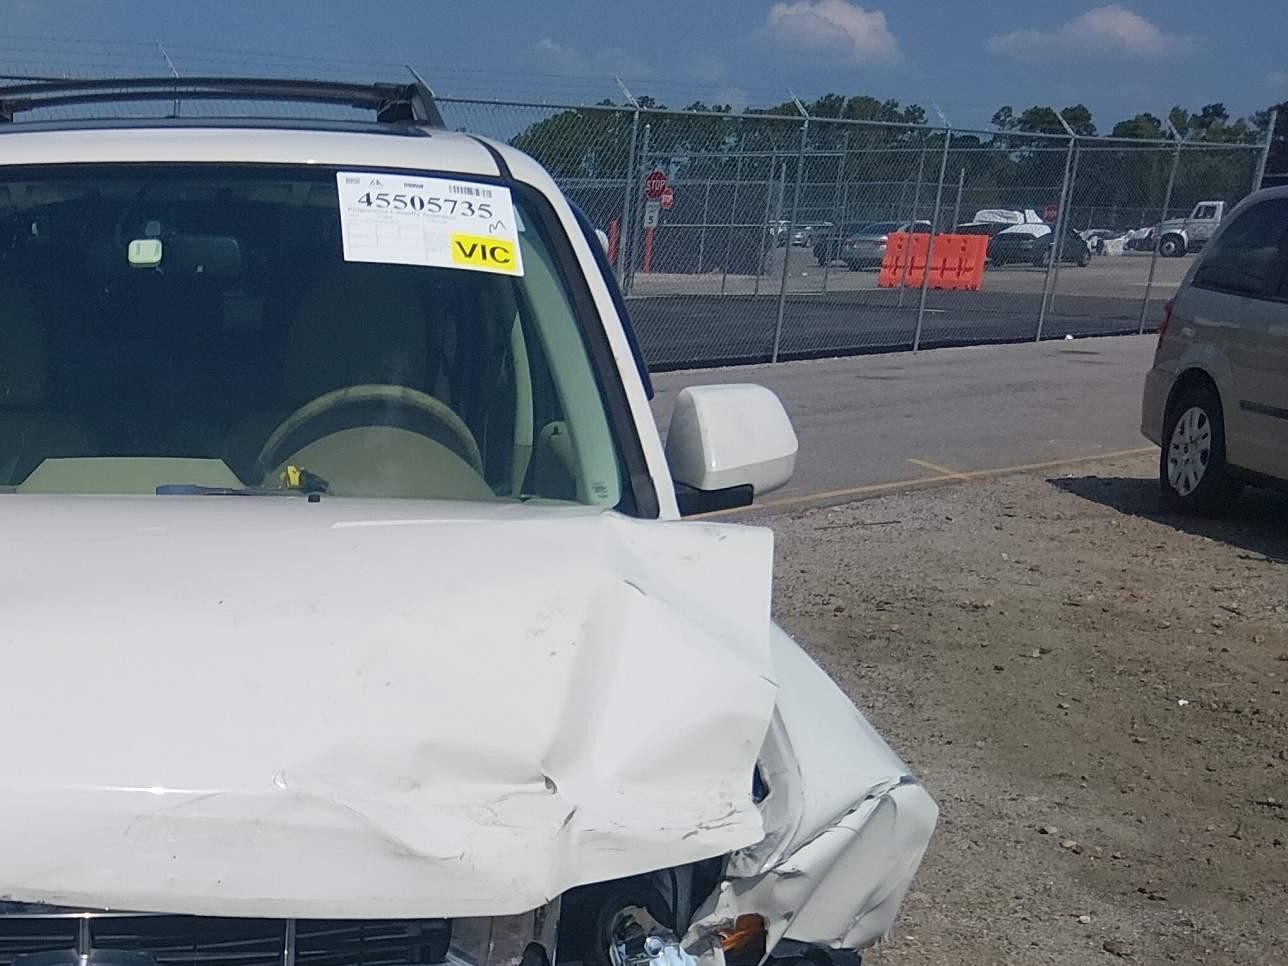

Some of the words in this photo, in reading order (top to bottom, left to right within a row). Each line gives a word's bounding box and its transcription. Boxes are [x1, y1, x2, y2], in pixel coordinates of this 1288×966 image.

[646, 179, 666, 191] STOP
[358, 191, 493, 219] 45505735
[648, 216, 654, 225] 5
[455, 240, 510, 264] VIC
